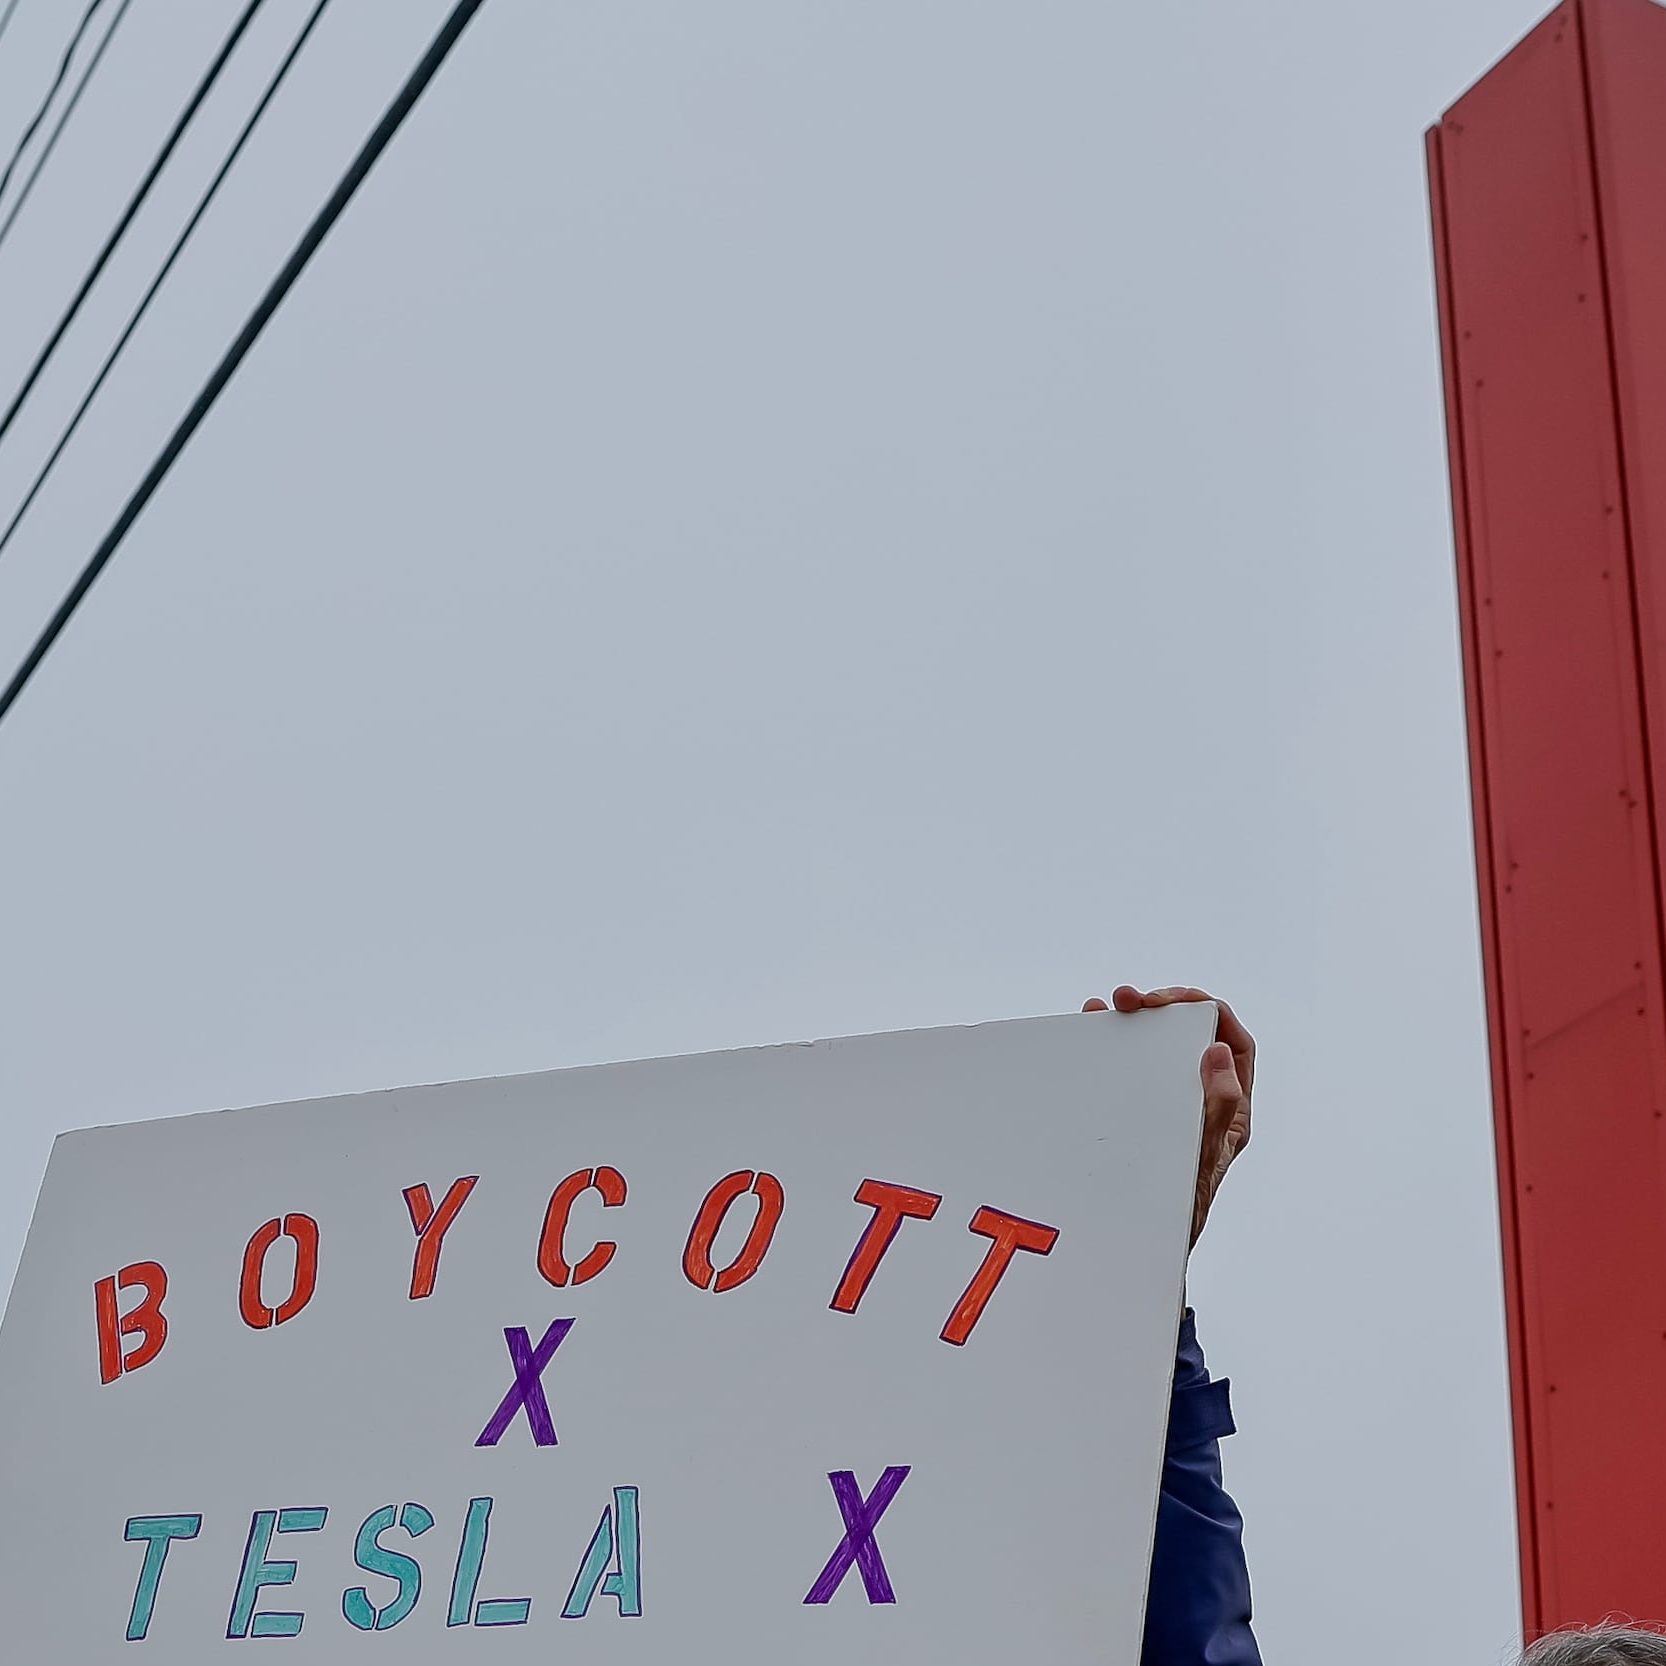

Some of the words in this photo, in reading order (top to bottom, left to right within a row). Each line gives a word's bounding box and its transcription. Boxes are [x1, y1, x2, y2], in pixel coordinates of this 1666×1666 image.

[94, 1166, 1060, 1385] BOYCOTT
[475, 1317, 576, 1447] X
[124, 1486, 642, 1641] TESLA
[803, 1465, 910, 1605] X
